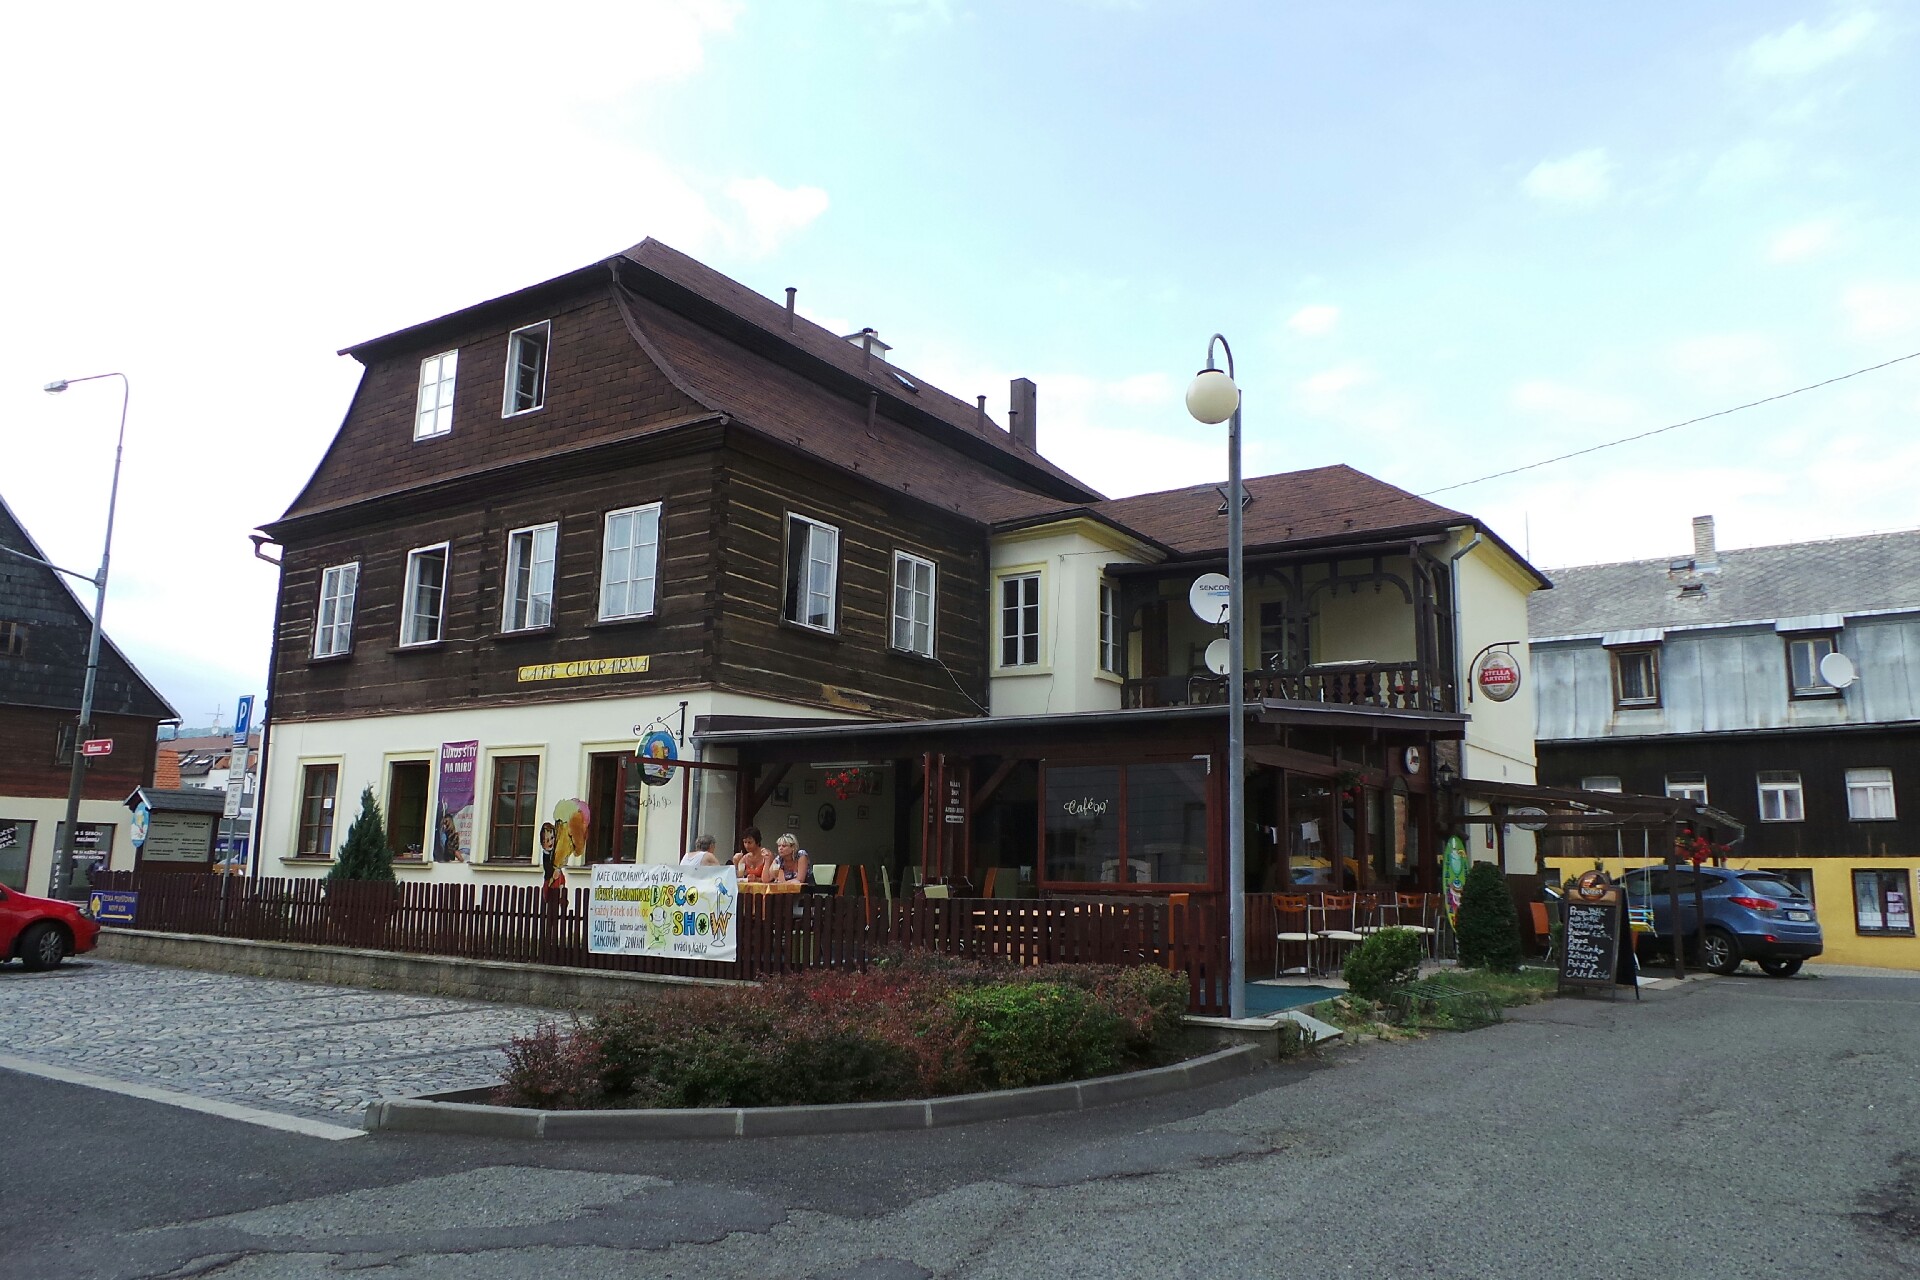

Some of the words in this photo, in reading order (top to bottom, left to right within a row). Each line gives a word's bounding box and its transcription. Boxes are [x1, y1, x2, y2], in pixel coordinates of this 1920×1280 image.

[443, 747, 462, 759] LUXUS
[444, 762, 454, 773] NA
[455, 759, 473, 773] MÍRU
[650, 884, 699, 908] DISCO
[672, 910, 732, 939] SHOW
